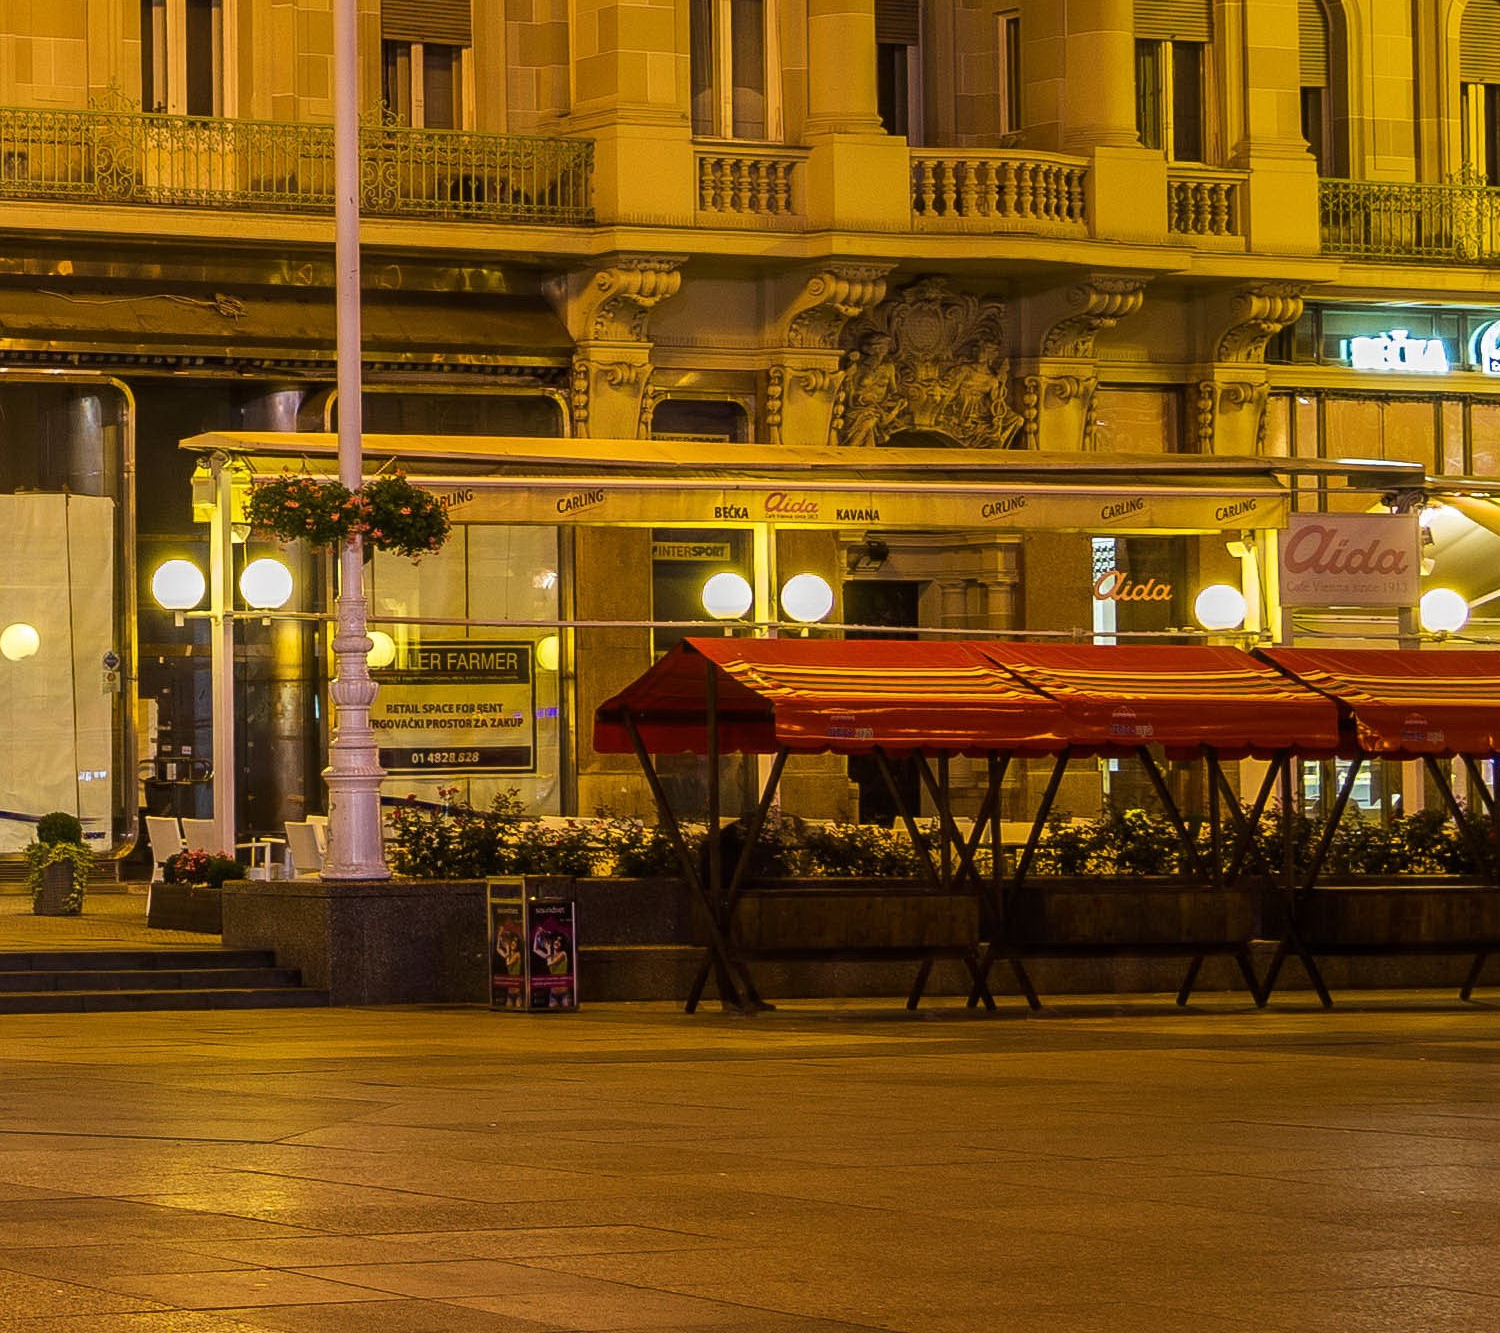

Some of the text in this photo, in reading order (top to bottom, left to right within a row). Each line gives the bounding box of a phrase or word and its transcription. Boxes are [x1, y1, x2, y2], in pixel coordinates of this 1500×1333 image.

[556, 489, 604, 514] CARLING
[981, 495, 1026, 519] CARLING
[1101, 497, 1144, 521] CARLING
[836, 509, 880, 521] KAVANA
[1215, 498, 1257, 522] CARLING
[659, 545, 726, 558] INTERSPORT
[447, 652, 518, 670] FARMER
[386, 704, 503, 714] RETAIL SPACE FOR RENT
[426, 718, 472, 729] PROSTOR
[474, 718, 488, 728] ZA
[490, 717, 524, 728] ZAKUP
[411, 752, 425, 763] 01
